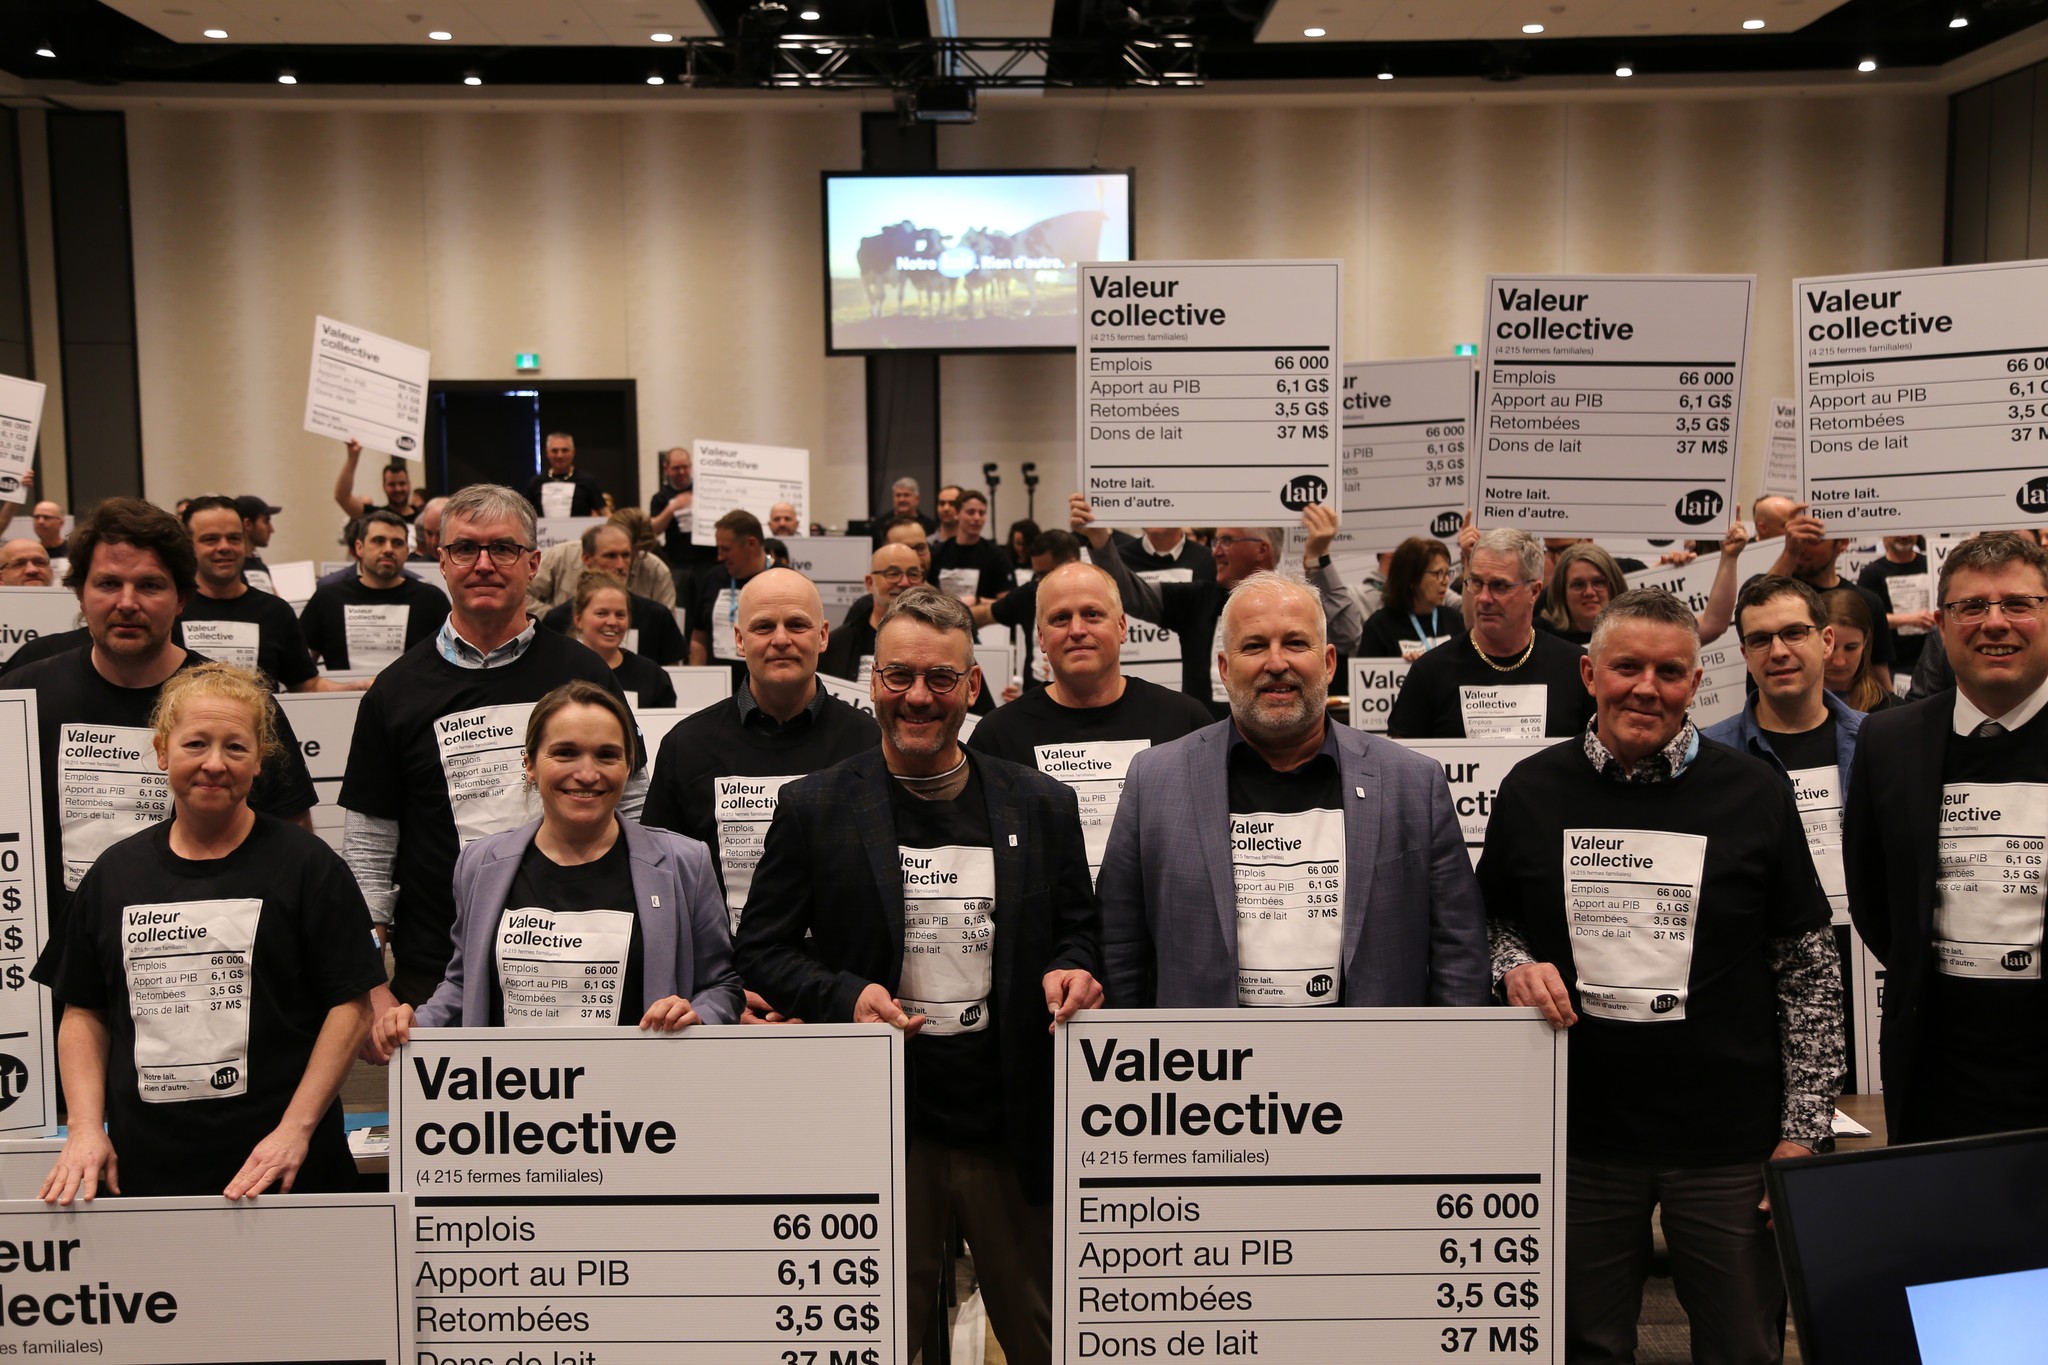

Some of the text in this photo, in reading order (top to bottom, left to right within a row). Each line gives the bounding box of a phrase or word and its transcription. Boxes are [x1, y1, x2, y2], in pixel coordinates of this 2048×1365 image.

[1090, 276, 1179, 298] Valeur
[1497, 288, 1589, 312] Valeur
[1807, 289, 1901, 313] Valeur
[1091, 304, 1226, 326] collective
[322, 324, 360, 344] Valeur
[1496, 316, 1634, 341] collective
[1809, 312, 1953, 341] collective
[1091, 333, 1188, 342] (4 215 fermes familiales)
[321, 339, 380, 363] collective
[1090, 356, 1329, 373] Emplois 66 000
[1493, 370, 1734, 386] Emplois 66 000
[1809, 369, 1874, 388] Emplois
[1090, 378, 1329, 397] Apport au PIB 6,1 G$
[1491, 393, 1732, 410] Apport au PIB 6,1 G$
[1809, 387, 1926, 411] Apport au PIB
[1091, 402, 1329, 418] Retombées 3,5 G$
[1490, 415, 1730, 433] Retombées 3,5 G$
[1810, 412, 1904, 431] Retombées
[1090, 425, 1329, 440] Dons de lait 37 M$
[1426, 426, 1464, 437] 66 000
[700, 446, 738, 458] Valeur
[1428, 442, 1464, 454] 6,1 G$
[1488, 438, 1729, 454] Dons de lait 37 M$
[1810, 435, 1908, 453] Dons de lait
[700, 457, 759, 471] collective
[1091, 477, 1154, 488] Notre lait.
[1285, 481, 1325, 502] lait
[1486, 488, 1550, 499] Notre lait.
[1812, 487, 1879, 500] Notre lait.
[1091, 496, 1174, 507] Rien d'autre.
[1679, 494, 1721, 516] lait
[1485, 507, 1568, 518] Rien d'autre.
[1812, 504, 1900, 519] Rien d'autre.
[187, 625, 217, 633] Valeur
[188, 632, 233, 641] collective
[1465, 691, 1498, 699] Valeur
[1466, 700, 1517, 709] collective
[440, 715, 486, 733] Valeur
[67, 730, 115, 743] Valeur
[444, 726, 513, 746] collective
[65, 746, 140, 760] collective
[1042, 749, 1086, 760] Valeur
[1045, 760, 1112, 772] collective
[721, 782, 765, 794] Valeur
[1231, 837, 1301, 851] collective
[1571, 836, 1624, 850] Valeur
[1570, 853, 1653, 868] collective
[1308, 865, 1338, 874] 66 000
[1572, 884, 1691, 898] Emplois 66 000
[129, 911, 180, 926] Valeur
[509, 915, 555, 931] Valeur
[128, 925, 207, 943] collective
[504, 931, 582, 948] collective
[132, 956, 244, 972] Emplois 66 000
[585, 966, 617, 974] 66 000
[1079, 1038, 1253, 1082] Valeur
[413, 1057, 584, 1100] Valeur
[1081, 1092, 1342, 1137] collective
[416, 1111, 676, 1155] collective
[1081, 1148, 1269, 1166] (4 215 fermes familiales)
[416, 1167, 603, 1185] (4 215 fermes familiales)
[1080, 1193, 1539, 1228] Emplois 66 000
[416, 1214, 878, 1248] Emplois 66 000
[1079, 1234, 1539, 1274] Apport au PIB 6,1 G$
[415, 1256, 879, 1293] Apport au PIB 6,1 G$
[1080, 1279, 1539, 1313] Retombées 3,5 G$
[417, 1302, 879, 1336] Retombées 3,5 G$
[22, 1339, 103, 1355] familiales)
[1079, 1324, 1538, 1357] Dons de lait 37 M$
